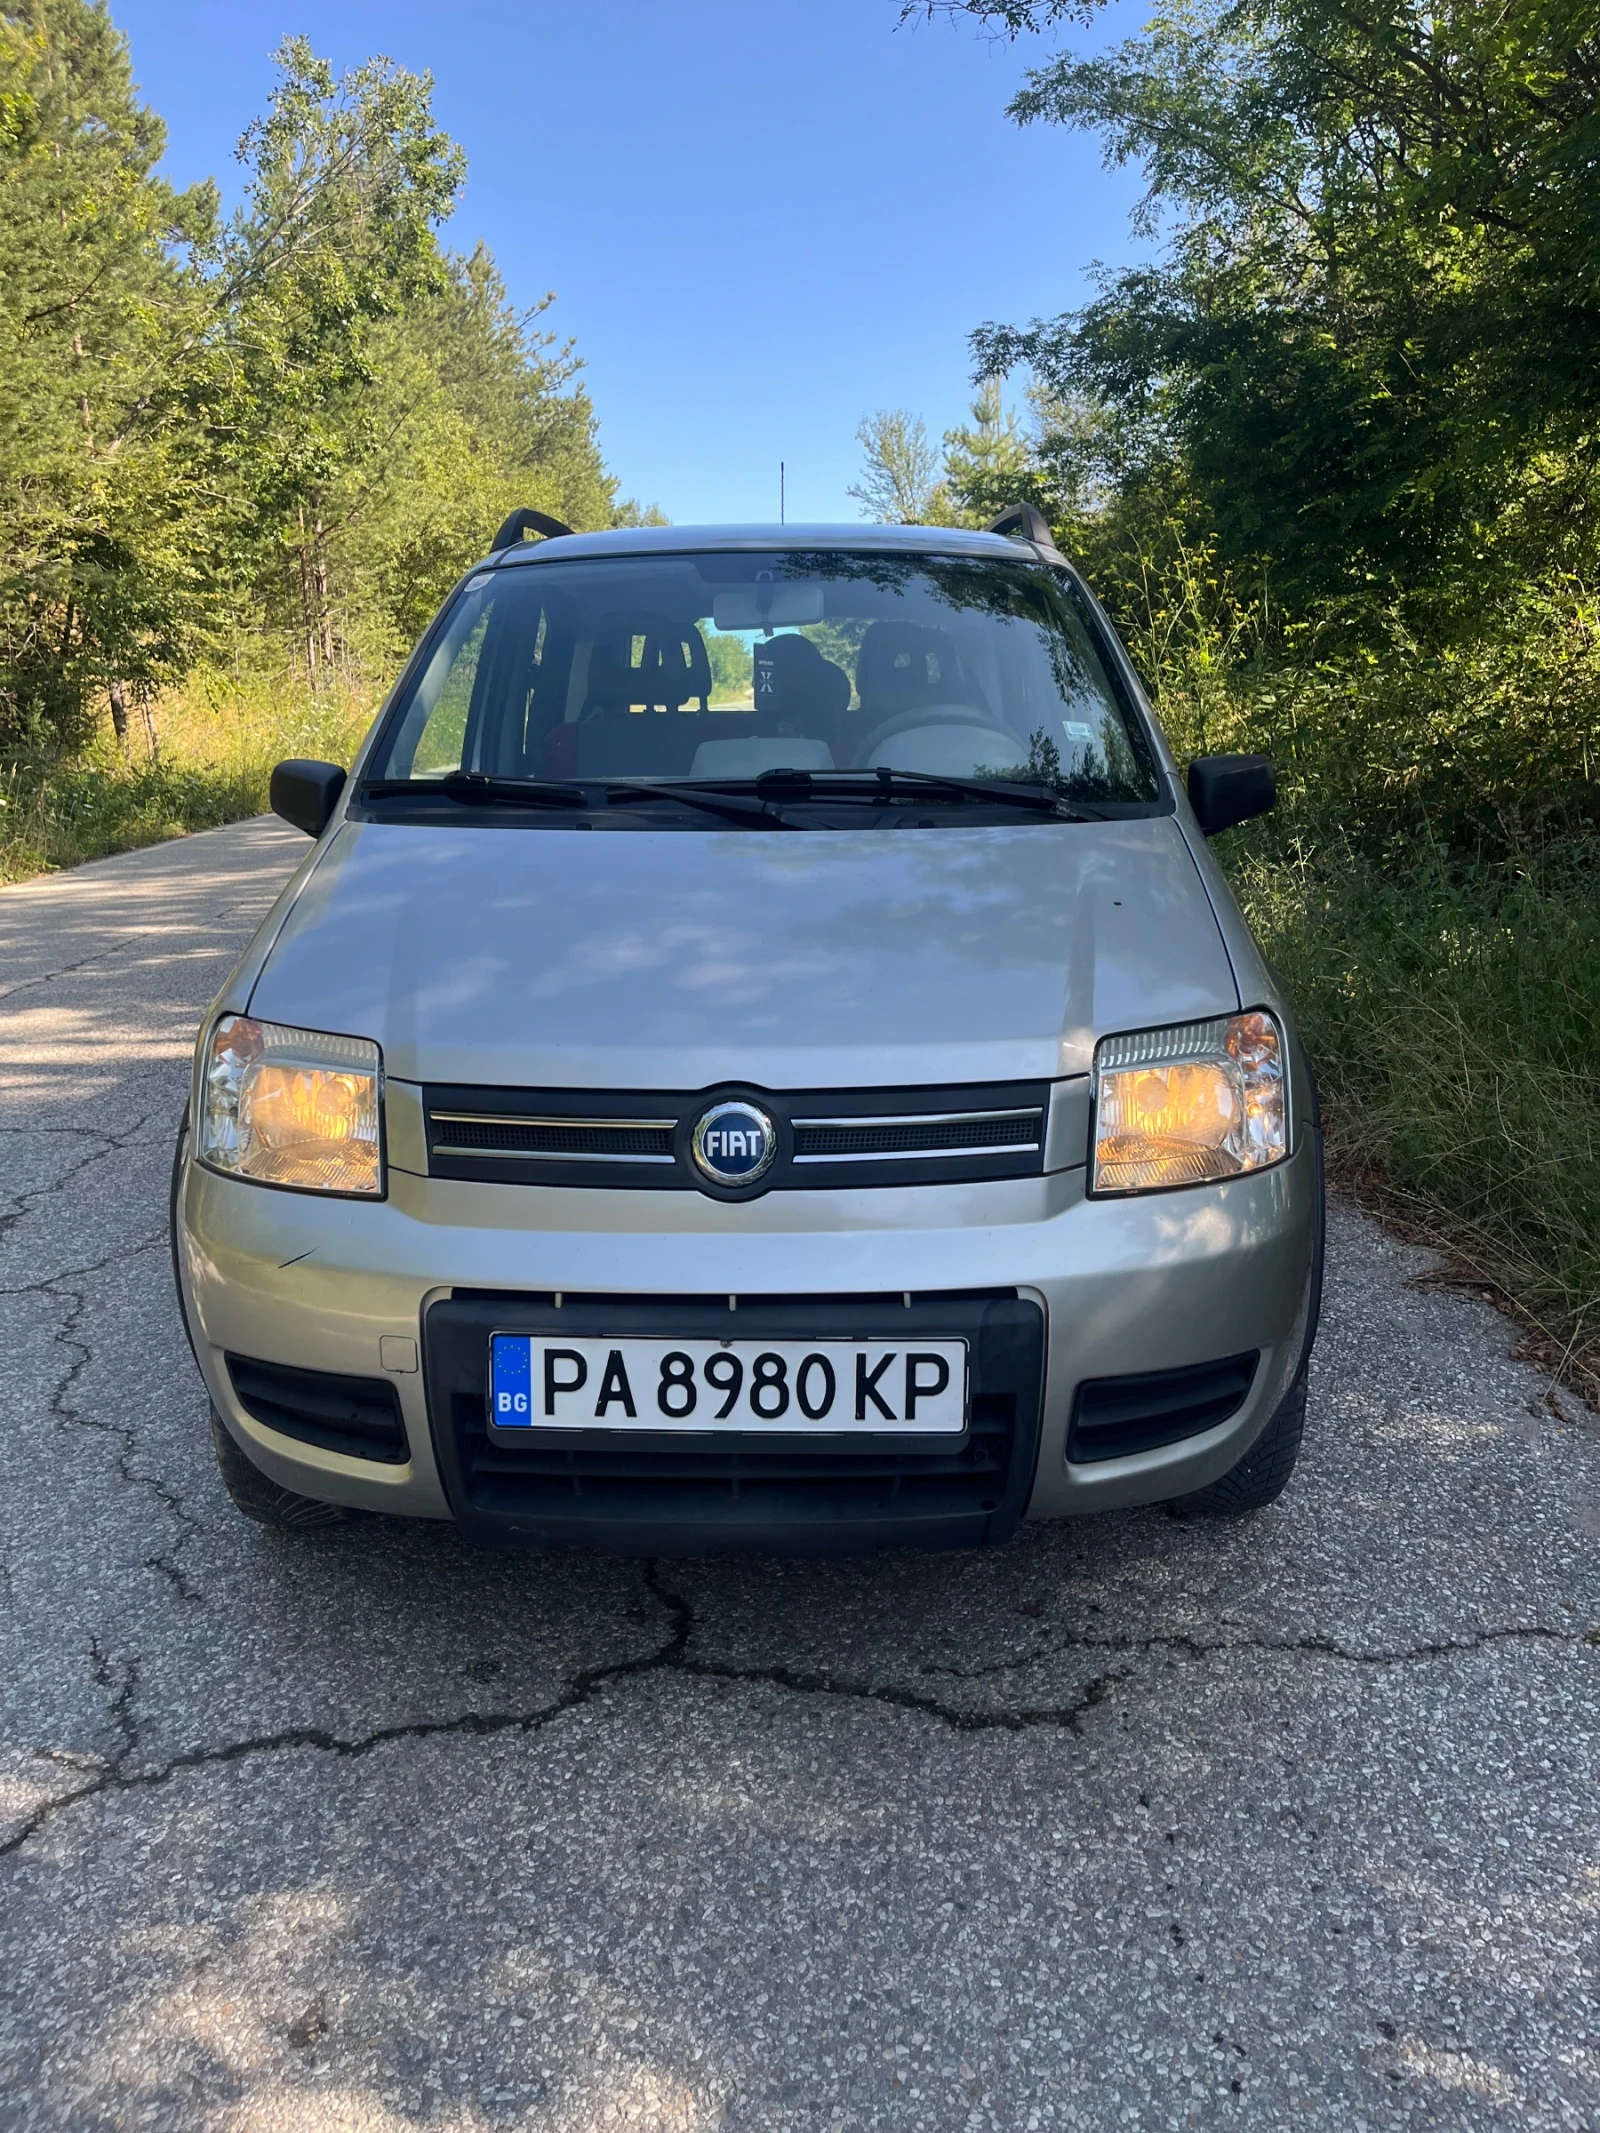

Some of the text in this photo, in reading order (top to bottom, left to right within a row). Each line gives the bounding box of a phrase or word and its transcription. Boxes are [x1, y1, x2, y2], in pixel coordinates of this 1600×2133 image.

[707, 1130, 761, 1157] FIAT
[544, 1348, 950, 1421] PA 8980 KP
[498, 1392, 528, 1413] BG
